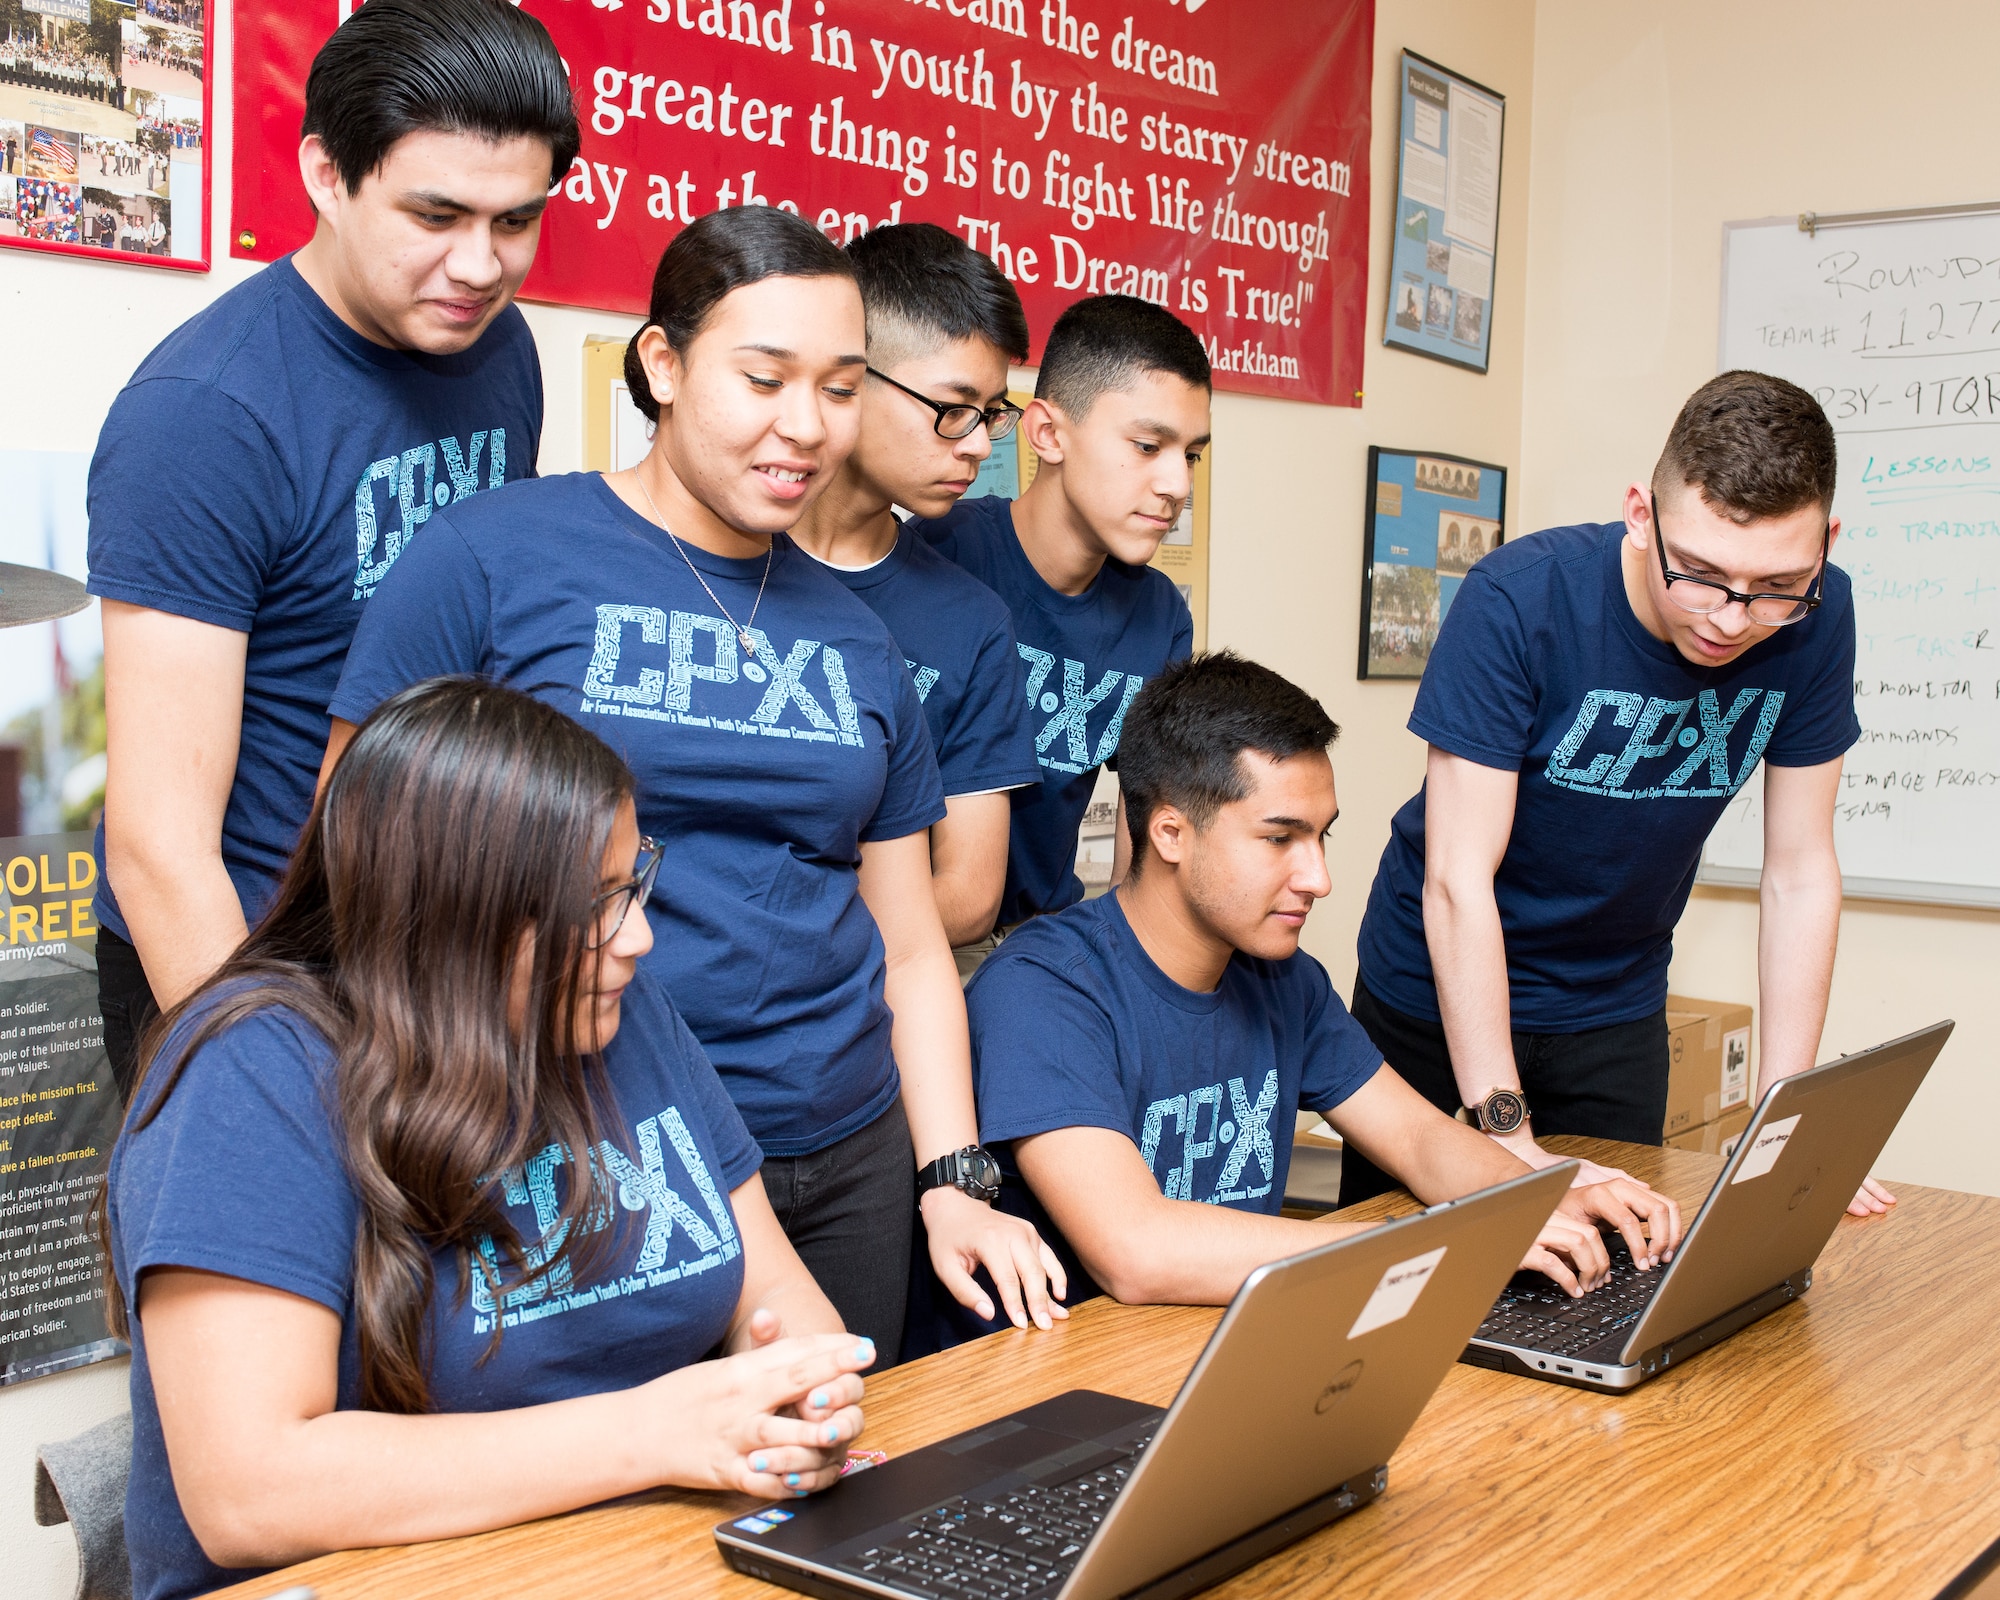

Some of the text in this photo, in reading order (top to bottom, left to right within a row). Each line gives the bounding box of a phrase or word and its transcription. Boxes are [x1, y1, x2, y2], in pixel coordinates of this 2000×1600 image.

[24, 0, 89, 20] CHALLENGE
[1041, 0, 1100, 59] the
[1111, 16, 1219, 96] dream
[646, 0, 793, 54] stand
[810, 1, 857, 72] in
[870, 38, 996, 110] youth
[1011, 60, 1059, 141] by
[1071, 82, 1128, 143] the
[1141, 112, 1248, 185] starry
[1253, 140, 1351, 197] stream
[592, 65, 792, 148] greater
[944, 126, 977, 188] is
[992, 146, 1031, 200] to
[1042, 150, 1136, 230] fight
[1147, 174, 1204, 234] life
[1211, 192, 1329, 272] through
[647, 169, 695, 225] at
[957, 215, 1040, 284] The
[1050, 234, 1170, 307] Dream
[1180, 260, 1209, 314] is
[1218, 267, 1313, 328] True!"
[1199, 333, 1299, 381] Markham
[1861, 455, 1992, 484] LESSONS
[580, 698, 595, 713] Air
[595, 699, 620, 716] Force
[622, 702, 677, 724] Association's
[677, 711, 711, 728] National
[710, 716, 735, 731] Youth
[735, 719, 759, 736] Cyber
[759, 722, 791, 738] Defense
[790, 726, 837, 743] Competition
[0, 851, 97, 896] OLD
[14, 1002, 50, 1016] Soldier.
[0, 1027, 18, 1040] and
[20, 1027, 26, 1037] a
[29, 1021, 66, 1036] member
[68, 1017, 79, 1030] of
[80, 1018, 86, 1028] a
[20, 1046, 30, 1058] of
[32, 1045, 48, 1057] the
[50, 1039, 80, 1053] United
[18, 1060, 51, 1074] Values.
[21, 1091, 37, 1104] the
[40, 1086, 75, 1101] mission
[76, 1080, 99, 1095] first.
[24, 1109, 57, 1126] defeat.
[0, 1146, 99, 1174] ave a fallen comrade.
[18, 1180, 64, 1201] physically
[66, 1176, 83, 1189] and
[44, 1197, 53, 1208] in
[55, 1195, 70, 1207] my
[25, 1223, 40, 1235] my
[41, 1217, 68, 1231] arms,
[69, 1213, 84, 1225] my
[14, 1245, 31, 1259] and
[39, 1242, 54, 1253] am
[55, 1240, 62, 1249] a
[9, 1271, 19, 1281] to
[21, 1264, 55, 1279] deploy,
[57, 1255, 93, 1271] engage,
[10, 1282, 40, 1298] States
[42, 1278, 52, 1290] of
[54, 1270, 91, 1287] America
[93, 1267, 102, 1278] in
[473, 1315, 490, 1334] Air
[491, 1311, 519, 1331] Frce
[565, 1286, 599, 1310] National
[594, 1280, 620, 1301] Youth
[619, 1275, 647, 1296] Cyber
[645, 1268, 681, 1288] Defense
[679, 1252, 722, 1277] Competition
[0, 1310, 20, 1322] dian
[22, 1305, 32, 1317] of
[34, 1296, 73, 1314] freedom
[75, 1290, 92, 1304] and
[33, 1319, 67, 1336] Soldier.
